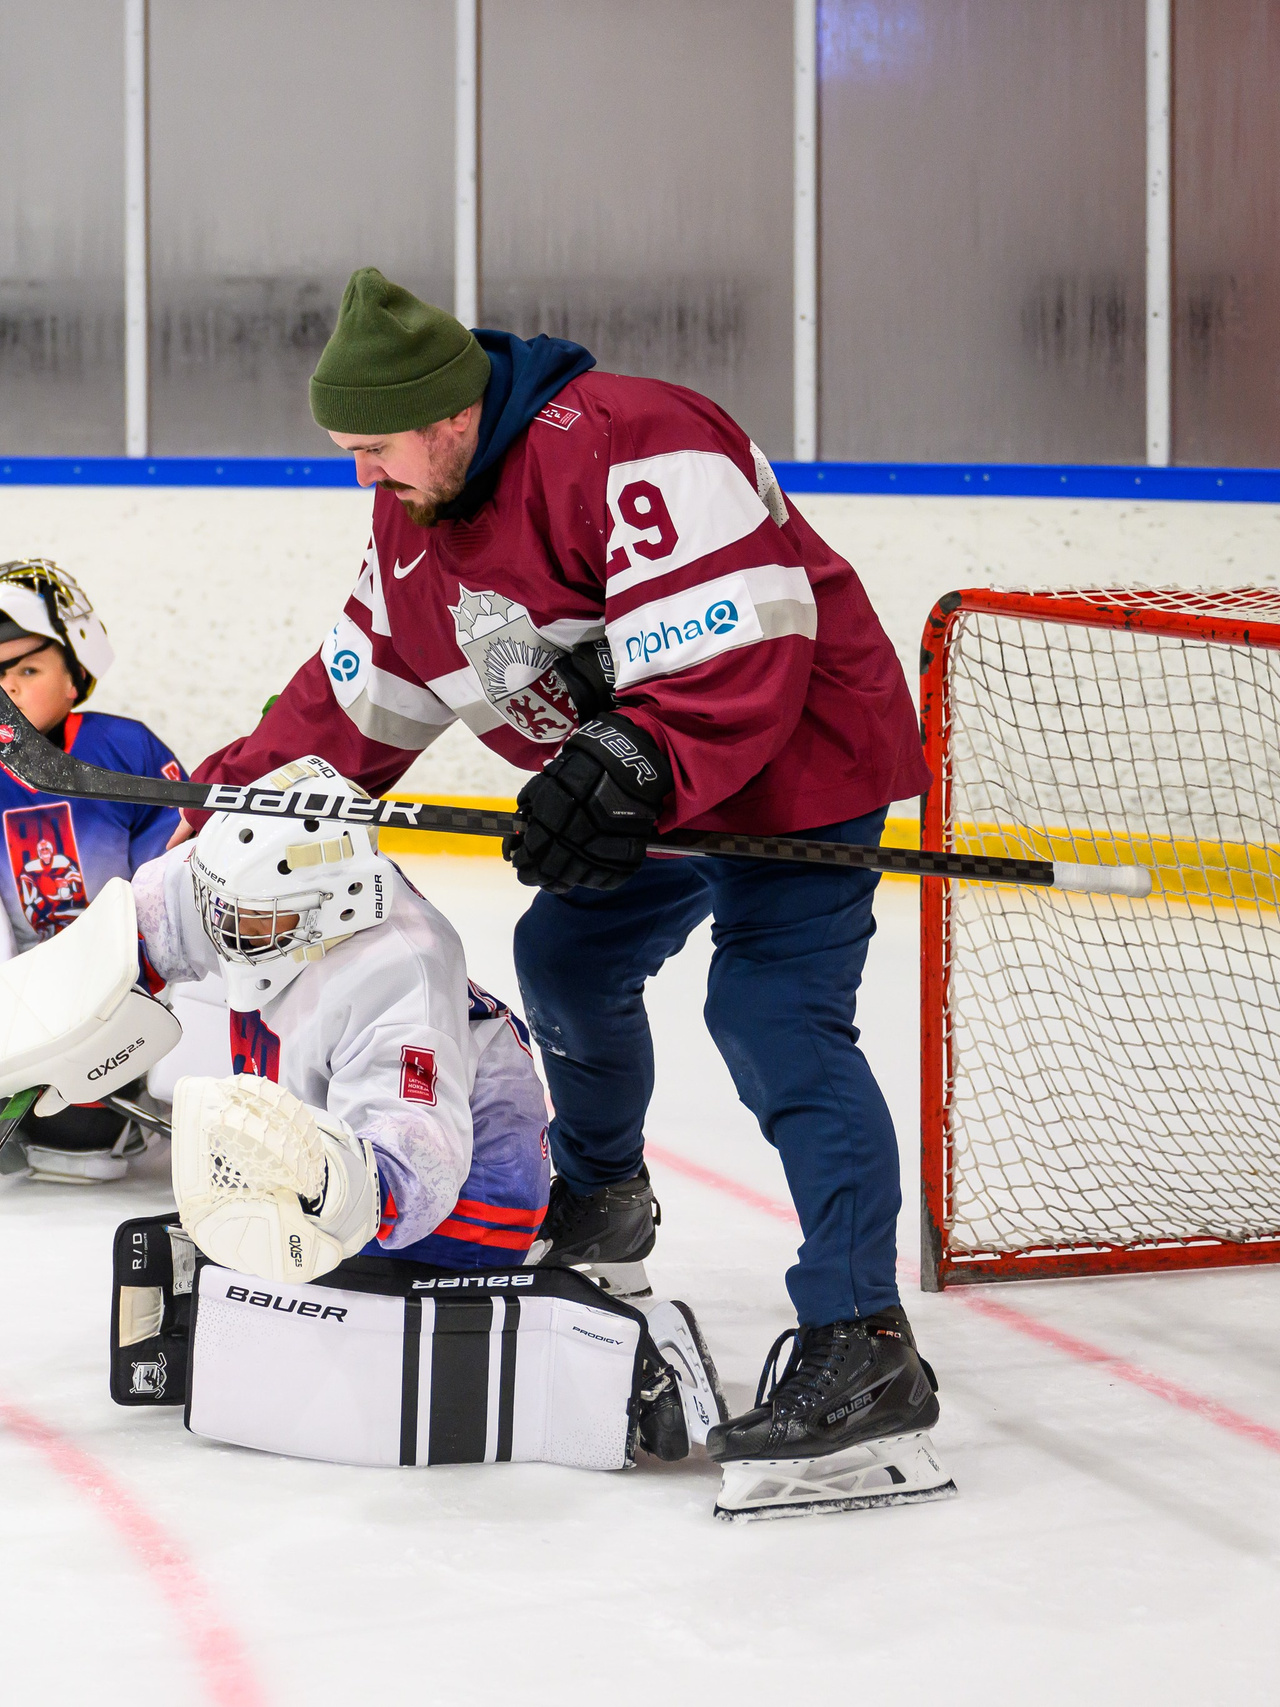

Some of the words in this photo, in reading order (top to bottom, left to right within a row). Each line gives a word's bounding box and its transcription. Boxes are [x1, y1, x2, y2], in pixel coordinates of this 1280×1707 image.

[307, 757, 337, 779] 940
[577, 718, 658, 786] UER
[203, 783, 423, 826] BAUER
[374, 874, 383, 919] BAUER
[226, 1285, 348, 1322] BAUER
[572, 1325, 624, 1346] PRODIGY
[876, 1329, 902, 1339] PRO
[826, 1392, 873, 1425] BAUER
